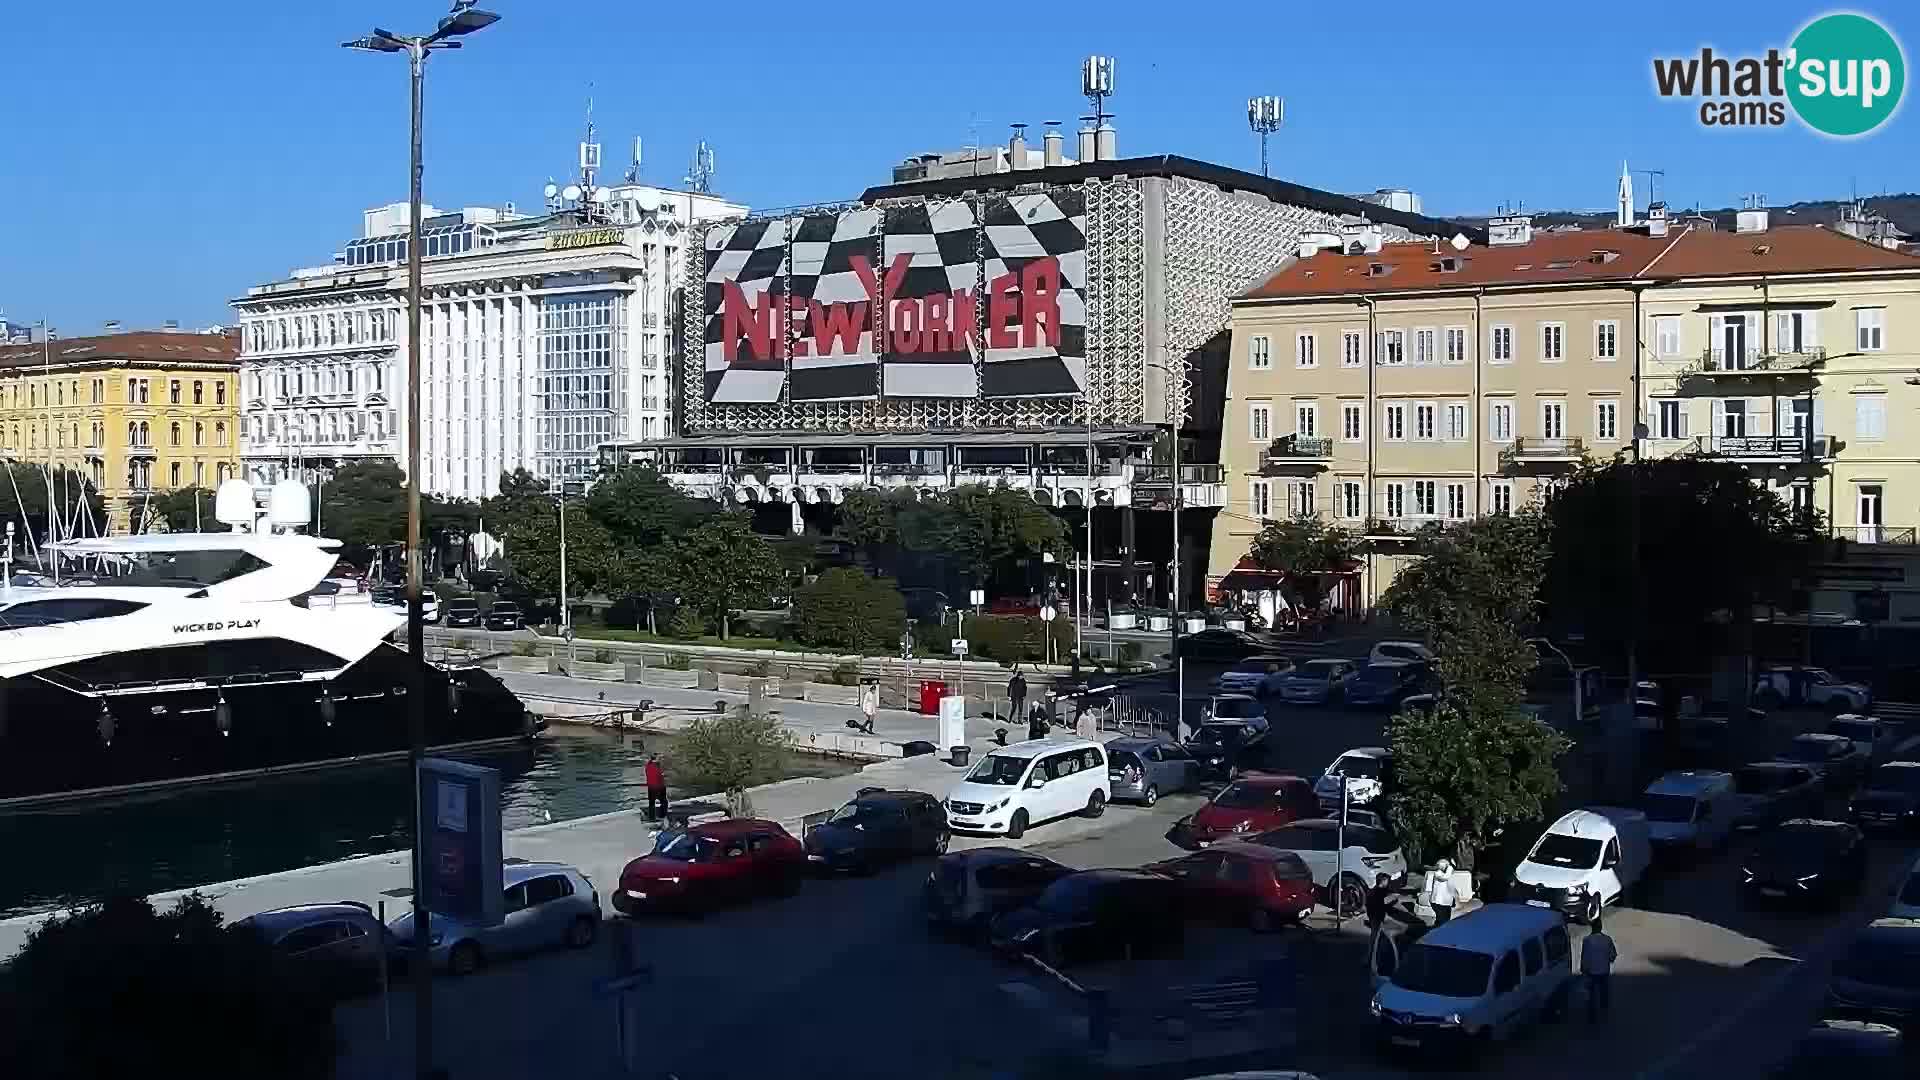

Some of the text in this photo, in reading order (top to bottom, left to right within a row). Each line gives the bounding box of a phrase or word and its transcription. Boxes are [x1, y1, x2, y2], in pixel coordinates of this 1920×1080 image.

[724, 252, 1062, 361] NEW YORKER
[173, 618, 261, 633] WICKED PLAY
